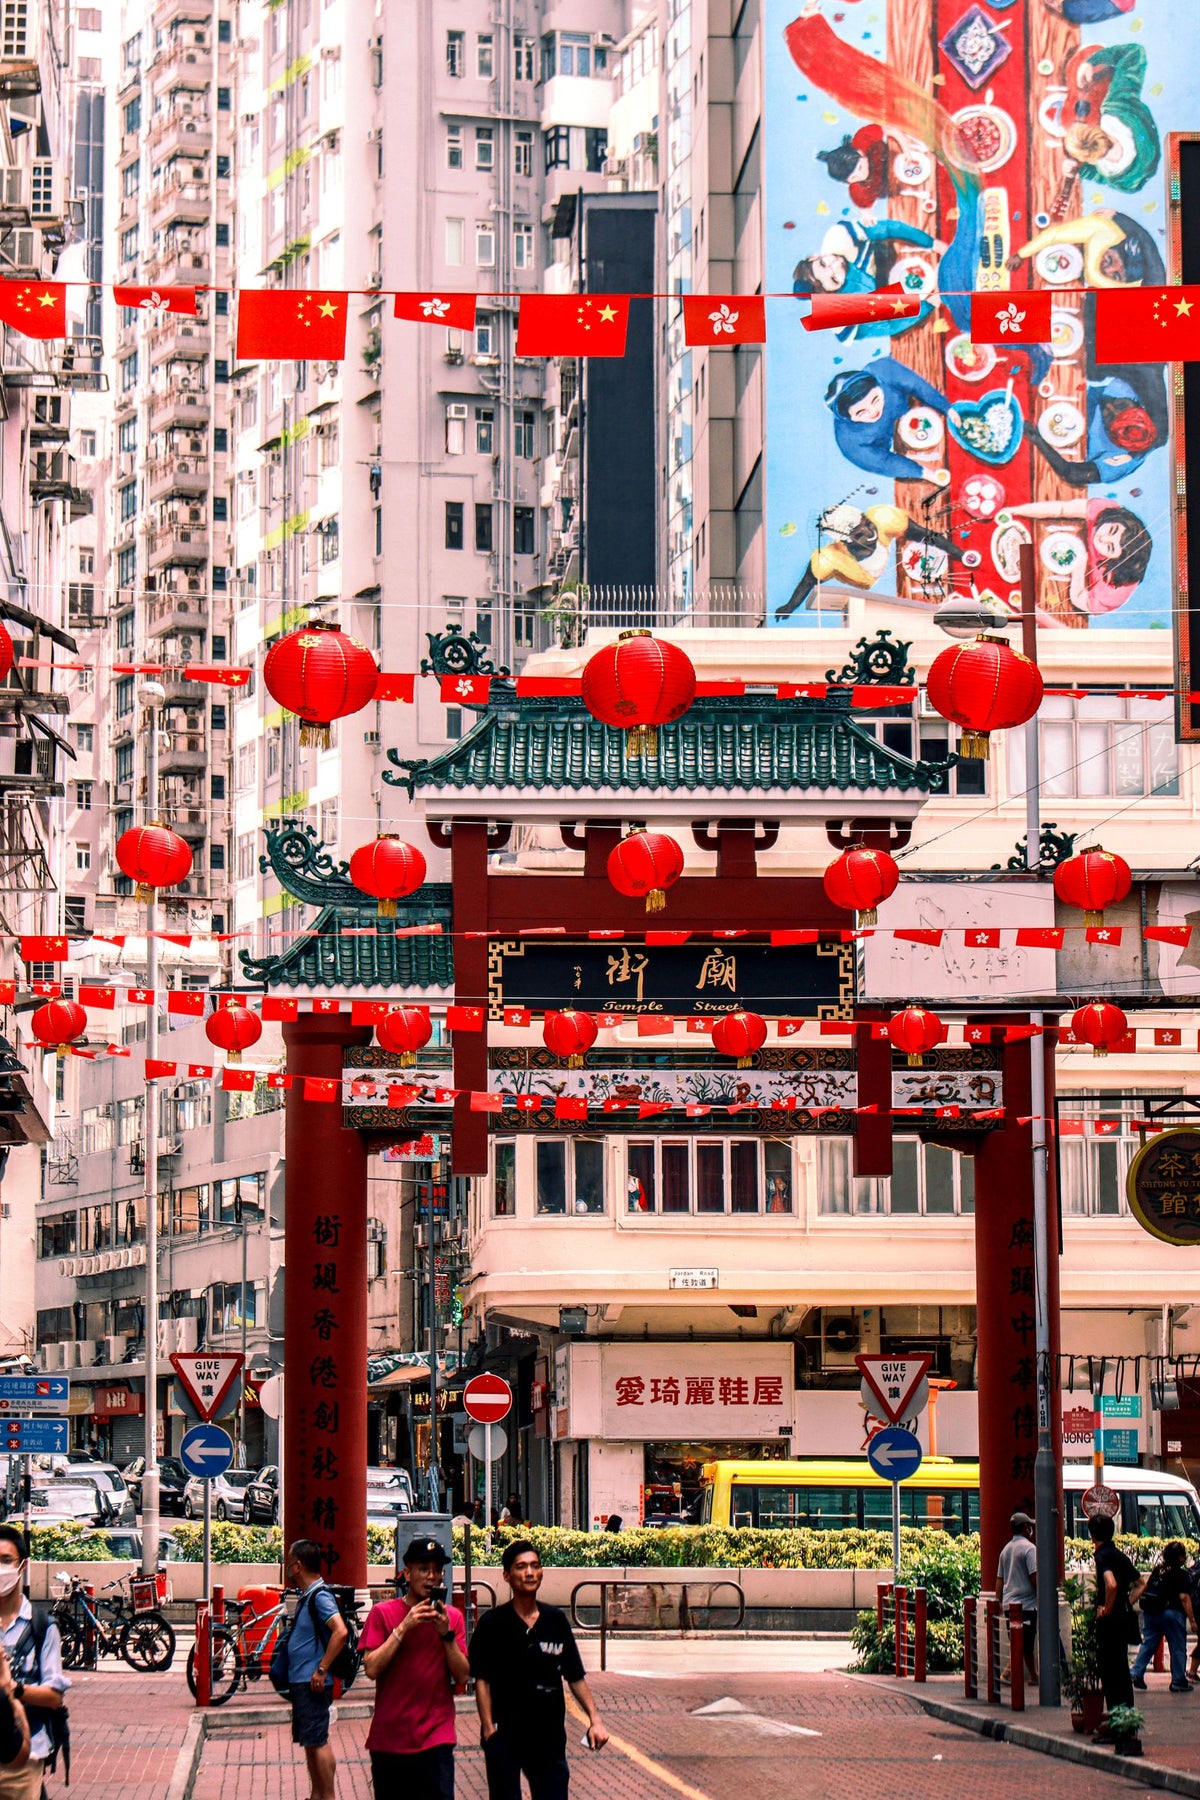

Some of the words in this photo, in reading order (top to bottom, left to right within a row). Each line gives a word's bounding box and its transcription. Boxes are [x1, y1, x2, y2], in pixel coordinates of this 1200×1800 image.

[602, 1001, 664, 1014] Temple
[693, 1001, 742, 1012] Street
[1141, 1181, 1176, 1189] SHEUNG
[1179, 1180, 1189, 1188] YU
[681, 1278, 707, 1287] 佐敦道
[195, 1361, 220, 1370] GIVE
[881, 1363, 907, 1372] GIVE
[195, 1372, 220, 1381] WAY
[882, 1373, 906, 1382] WAY
[201, 1385, 214, 1397] 讓
[615, 1375, 784, 1407] 愛琦麗鞋屋
[888, 1386, 901, 1399] 讓
